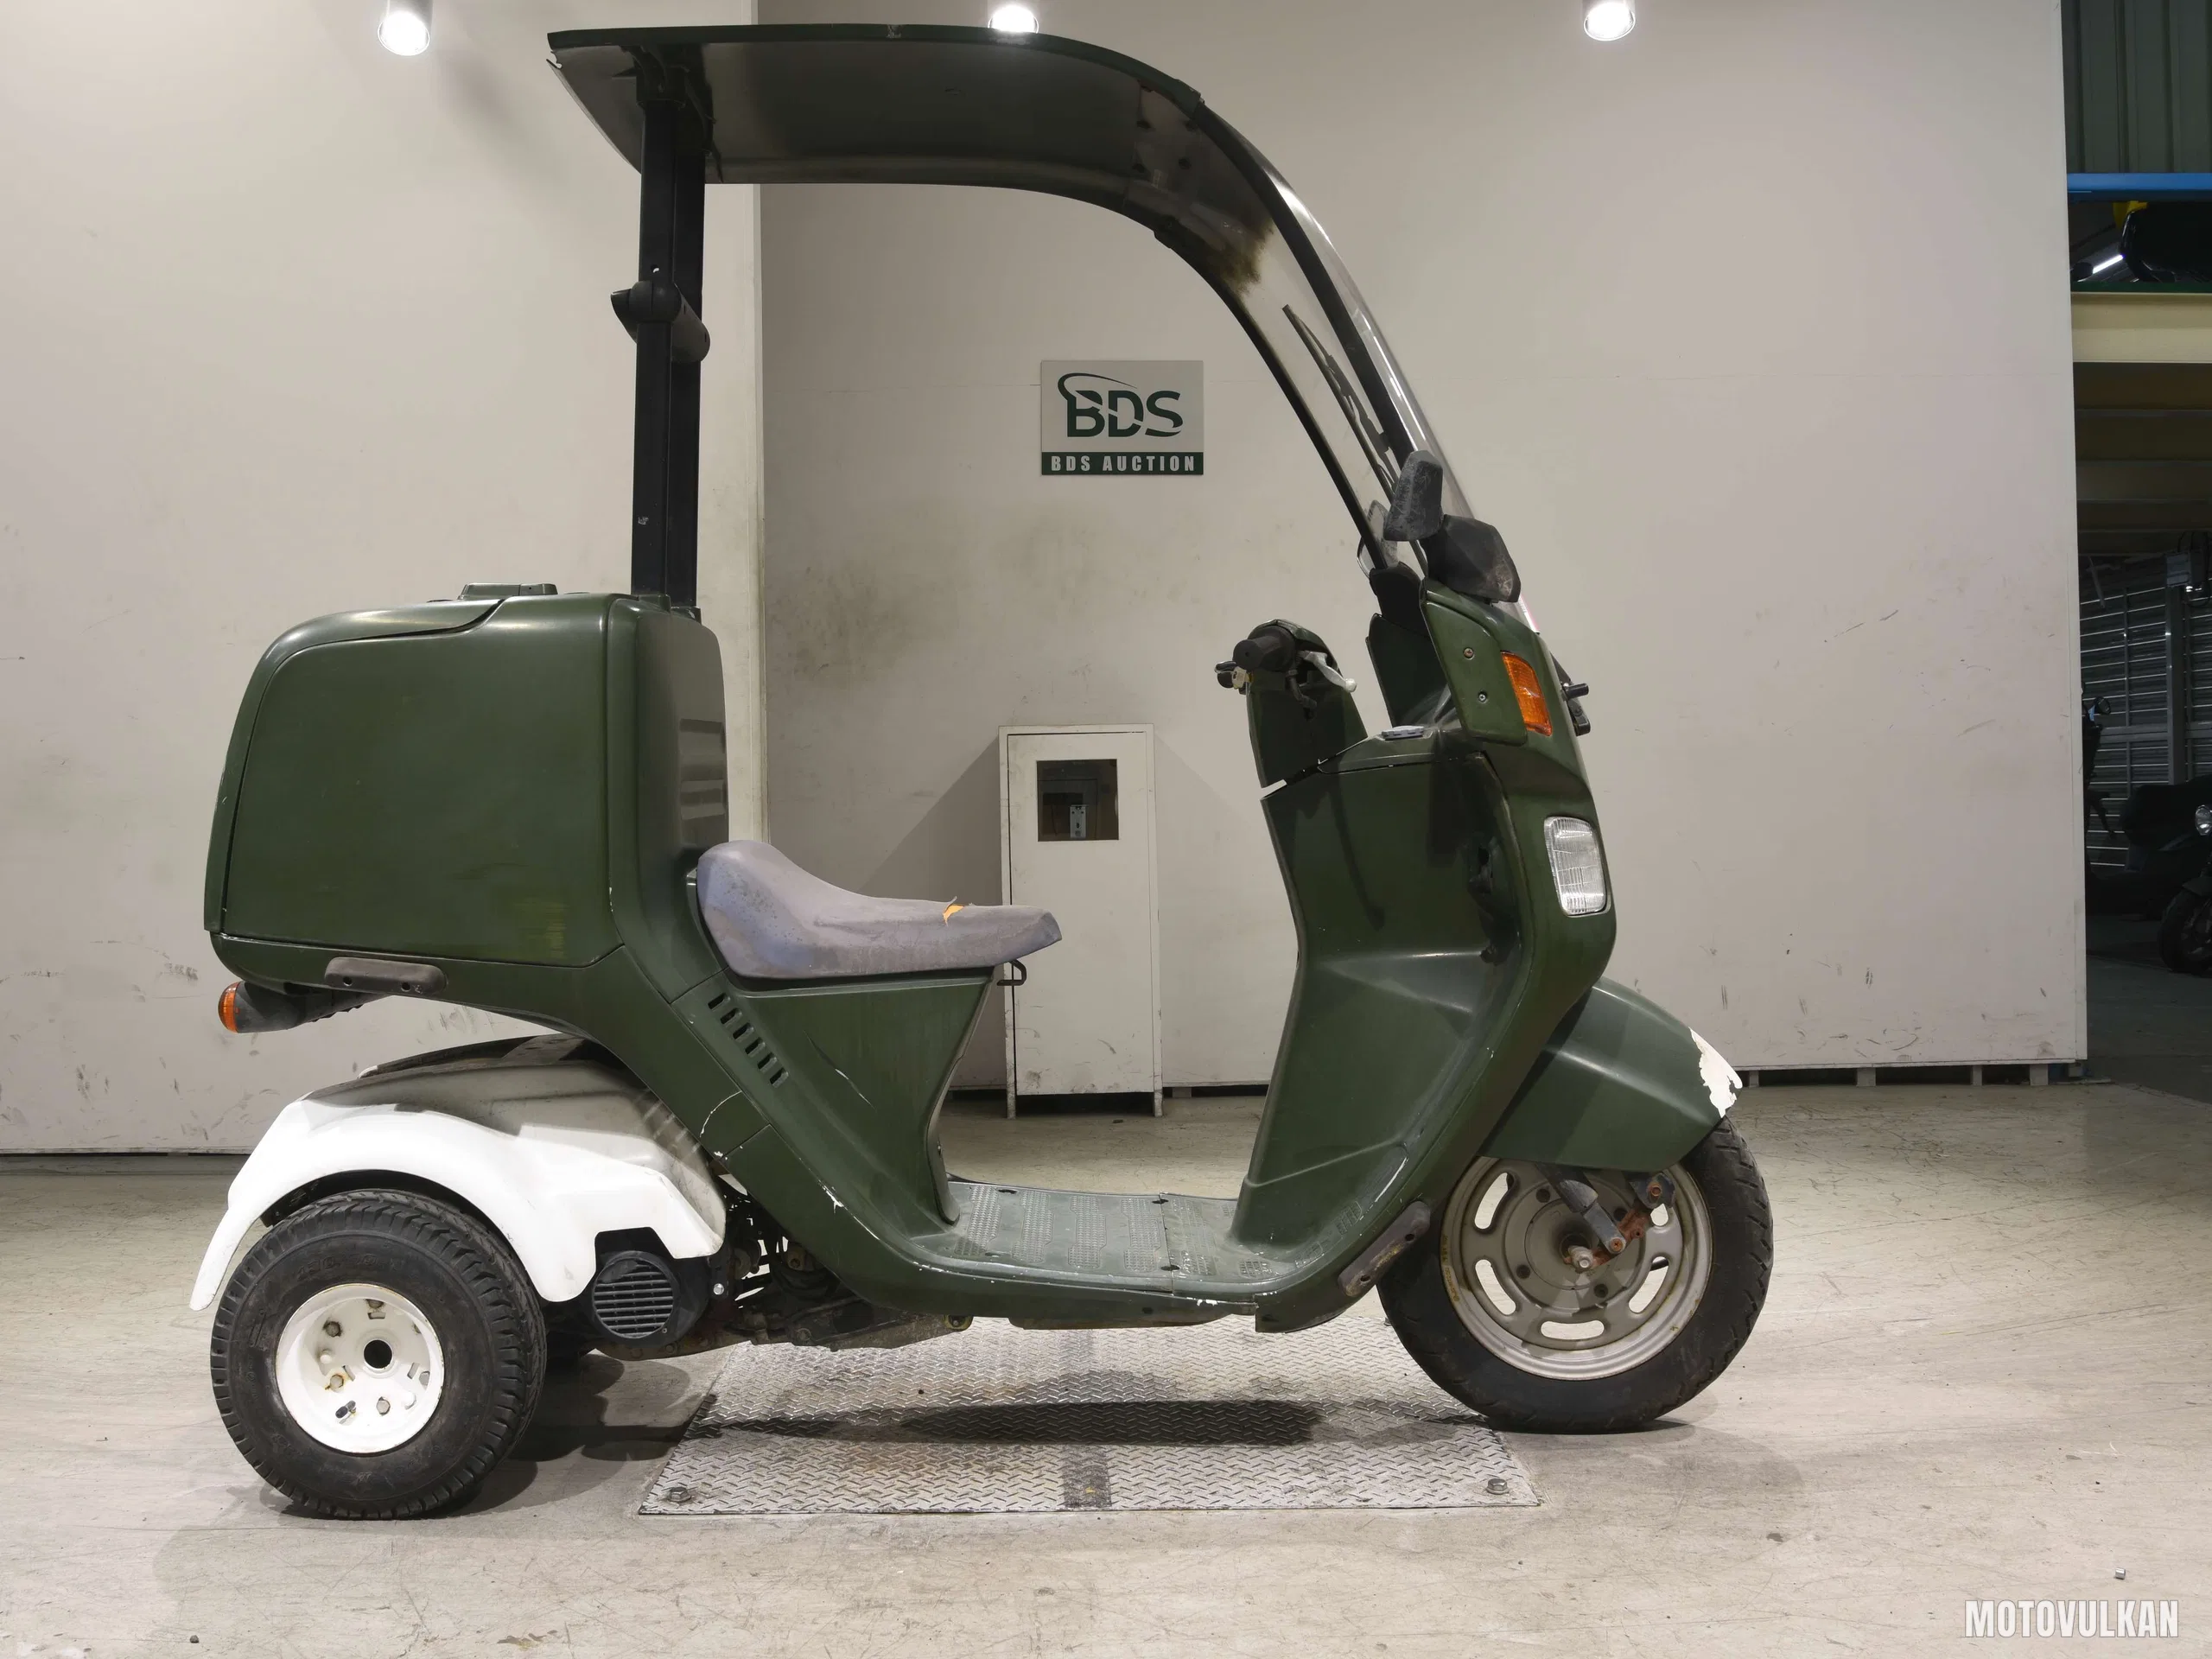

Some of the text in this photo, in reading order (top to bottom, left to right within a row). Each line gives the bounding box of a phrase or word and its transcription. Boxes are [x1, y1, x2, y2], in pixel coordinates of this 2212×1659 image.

[1058, 372, 1184, 438] BDS
[1051, 455, 1195, 472] BDS AUCTION
